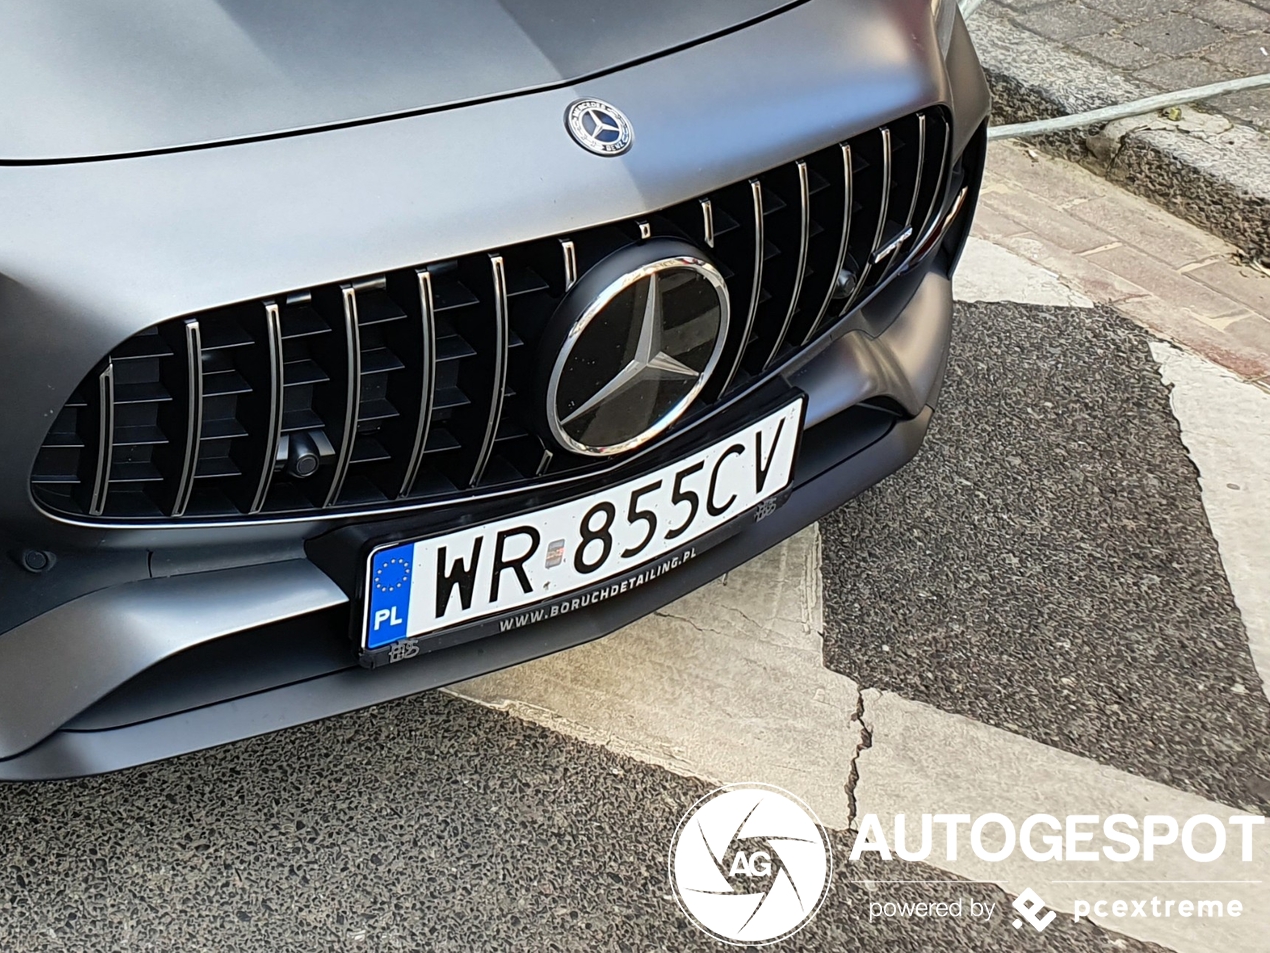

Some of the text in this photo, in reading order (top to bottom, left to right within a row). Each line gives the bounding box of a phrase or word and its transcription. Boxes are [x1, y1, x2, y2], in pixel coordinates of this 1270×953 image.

[435, 416, 787, 619] WR 855CV
[374, 607, 403, 631] PL
[499, 547, 697, 633] WWW.BORUCHDETAILING.PL
